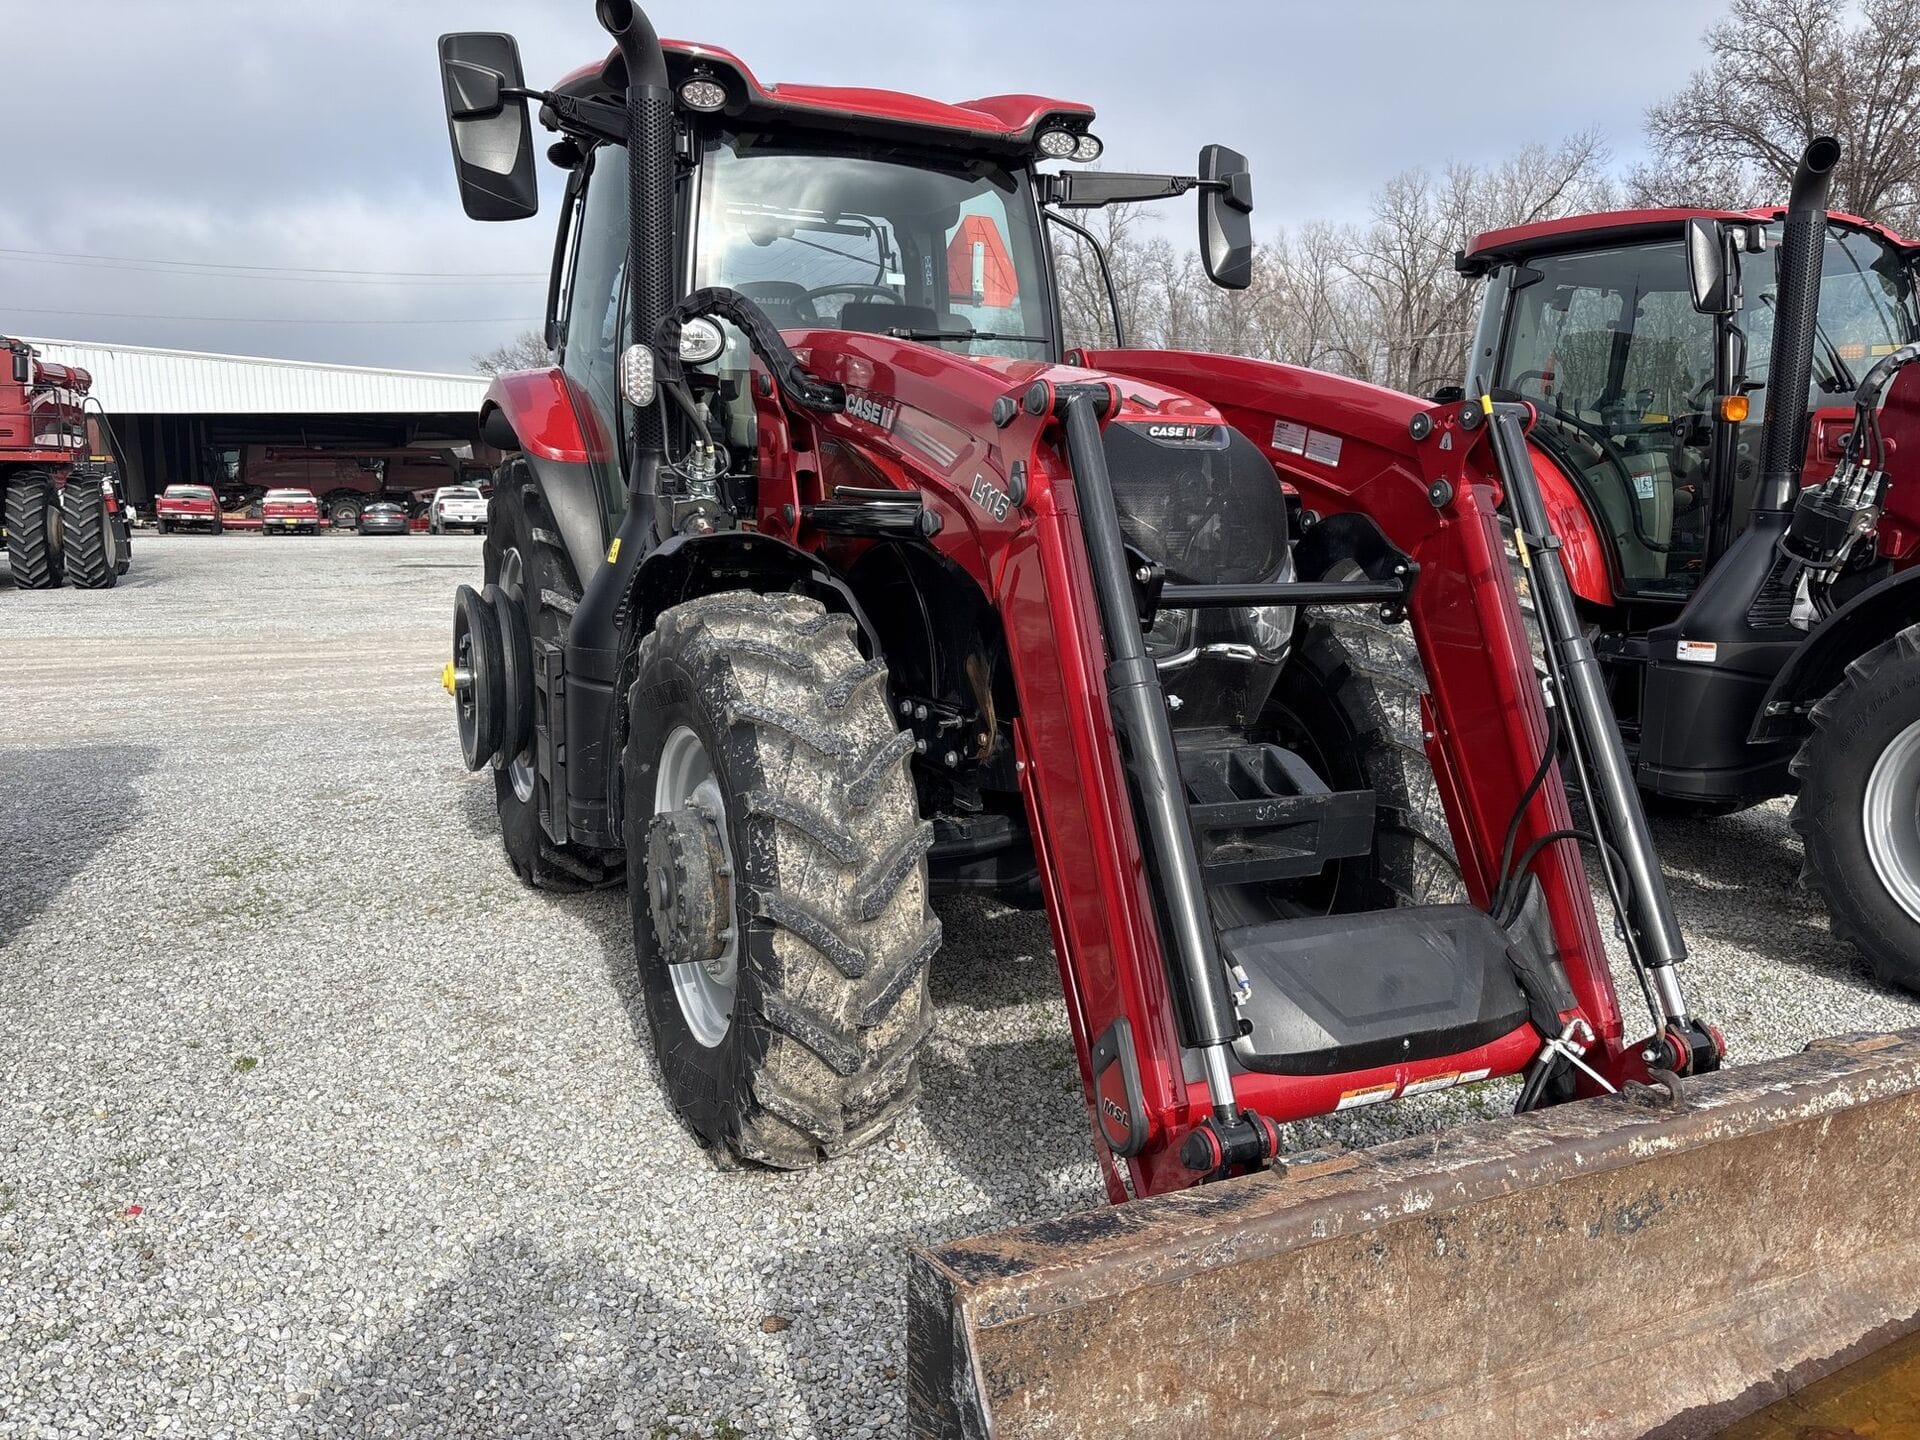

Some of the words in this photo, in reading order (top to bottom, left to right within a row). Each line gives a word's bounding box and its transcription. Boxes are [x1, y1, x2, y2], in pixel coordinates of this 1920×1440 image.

[846, 393, 881, 425] CASE
[1150, 426, 1184, 437] CASE
[970, 473, 1010, 523] L115
[1103, 1097, 1129, 1129] MSL
